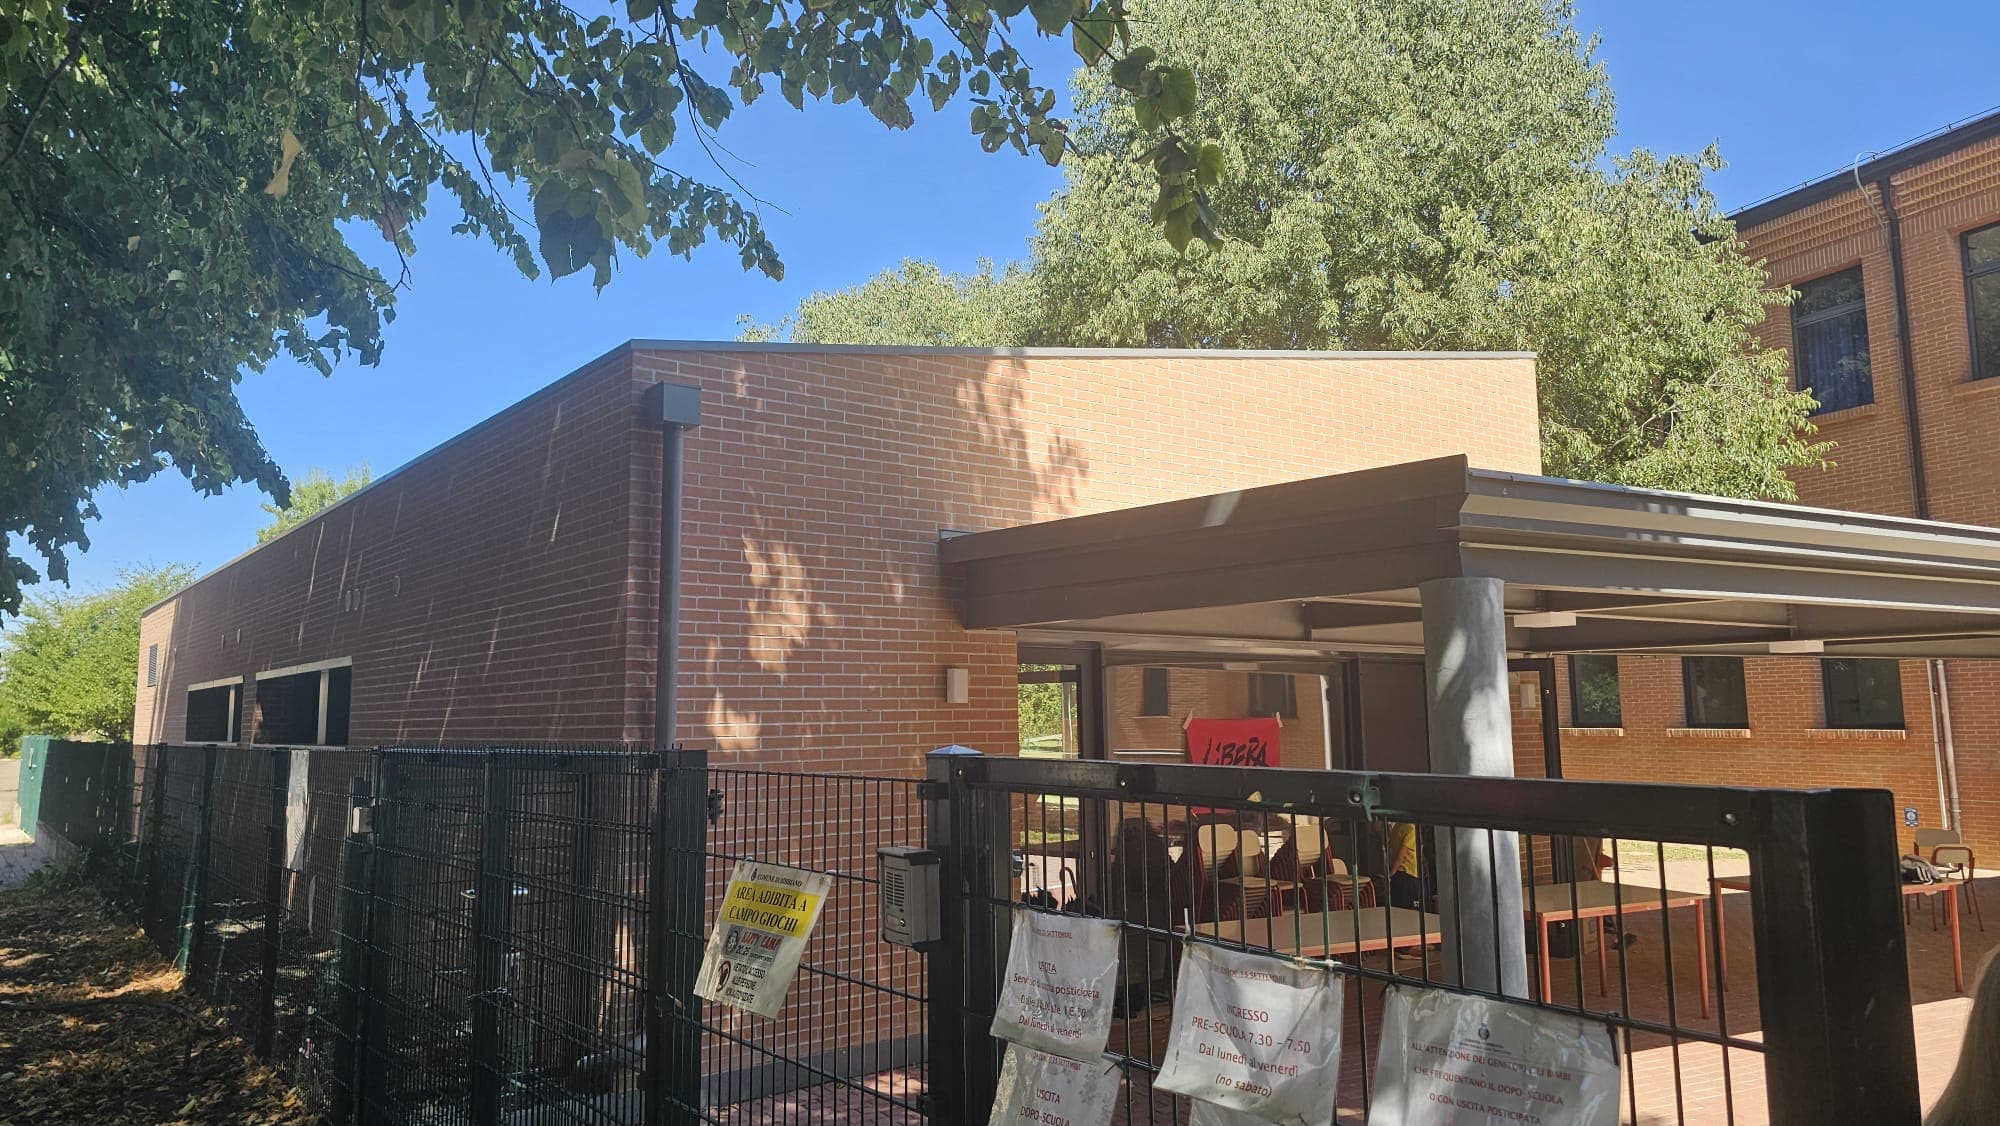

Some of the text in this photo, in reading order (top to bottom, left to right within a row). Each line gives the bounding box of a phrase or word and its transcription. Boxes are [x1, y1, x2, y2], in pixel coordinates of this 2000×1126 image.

[1202, 736, 1270, 767] LIBERA
[734, 886, 807, 912] AREA ADIBITA A
[729, 905, 799, 932] CAMPO GIOCHI
[1249, 1031, 1273, 1048] 7.30
[1286, 1038, 1311, 1054] 7.50
[1199, 1042, 1299, 1078] Dal lunedì al venerdì
[1215, 1072, 1273, 1098] (no sabato)
[1415, 1065, 1429, 1077] CHE
[1488, 1082, 1497, 1092] IL
[1036, 1087, 1061, 1105] USCITA
[1429, 1092, 1541, 1125] O CON USCITA POSTICIPATA
